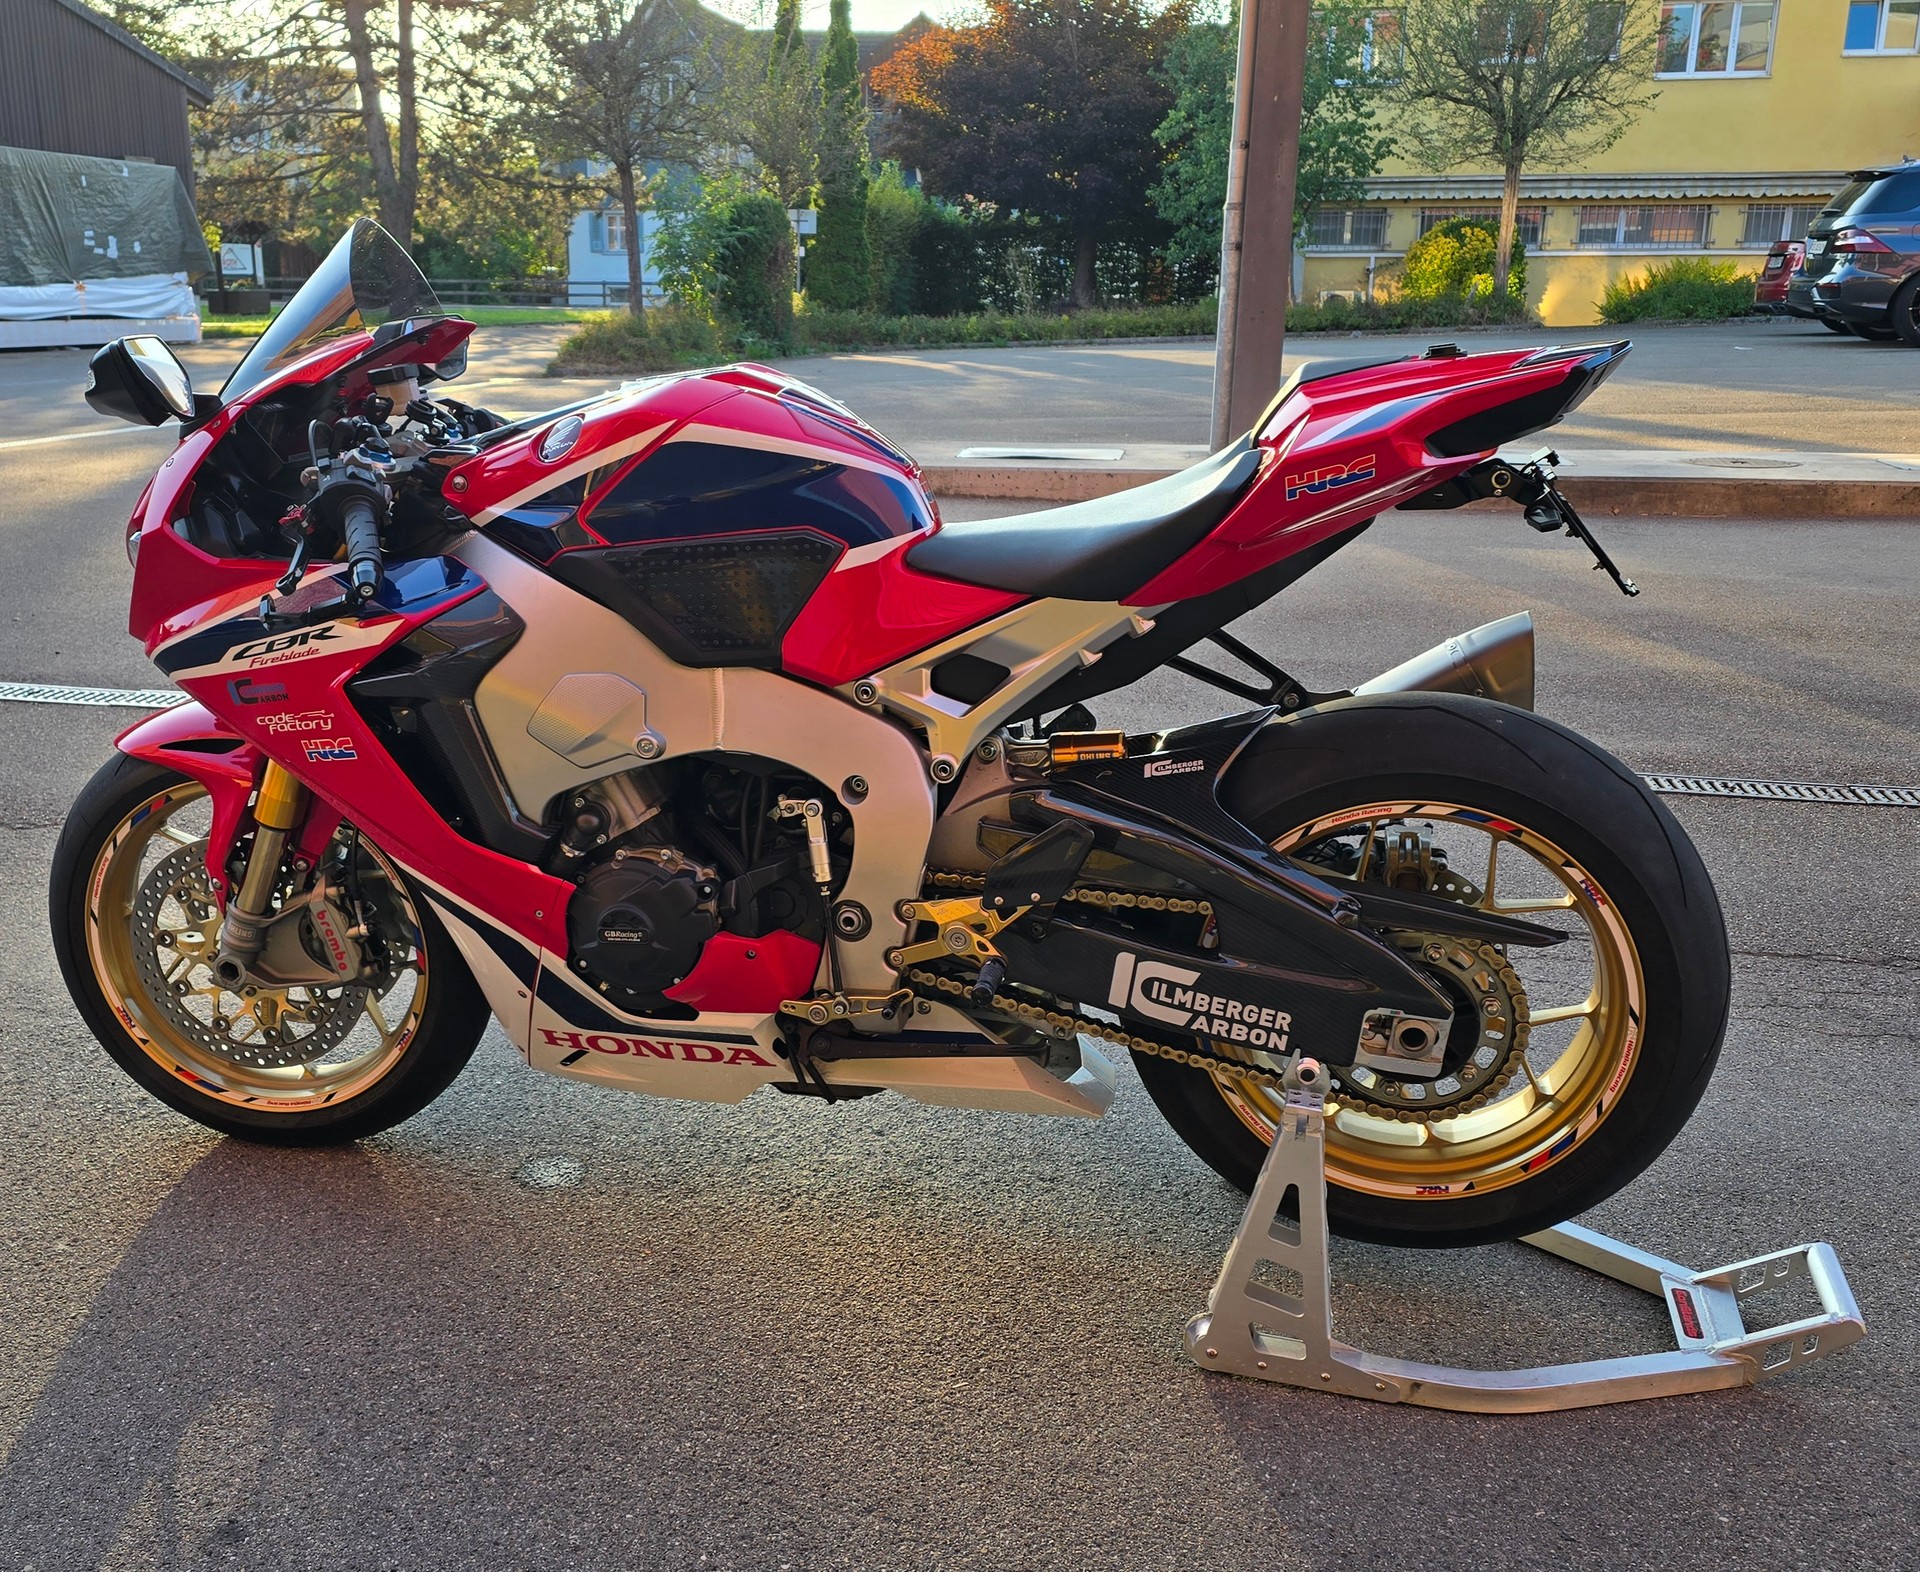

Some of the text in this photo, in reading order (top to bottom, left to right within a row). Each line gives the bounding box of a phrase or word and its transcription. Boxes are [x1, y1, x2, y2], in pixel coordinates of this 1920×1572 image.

[1285, 454, 1375, 501] HRC
[232, 625, 343, 661] CBR
[249, 646, 321, 668] Fireblade
[257, 711, 296, 725] code
[269, 718, 332, 735] factory
[301, 737, 358, 762] HRC
[1331, 806, 1393, 824] Honda Racing
[316, 909, 347, 971] brembo
[1150, 981, 1293, 1032] ILMBERGER
[537, 1028, 777, 1067] HONDA
[1622, 1040, 1634, 1067] Honda
[1609, 1066, 1626, 1092] Racing
[1239, 1104, 1261, 1127] Racing
